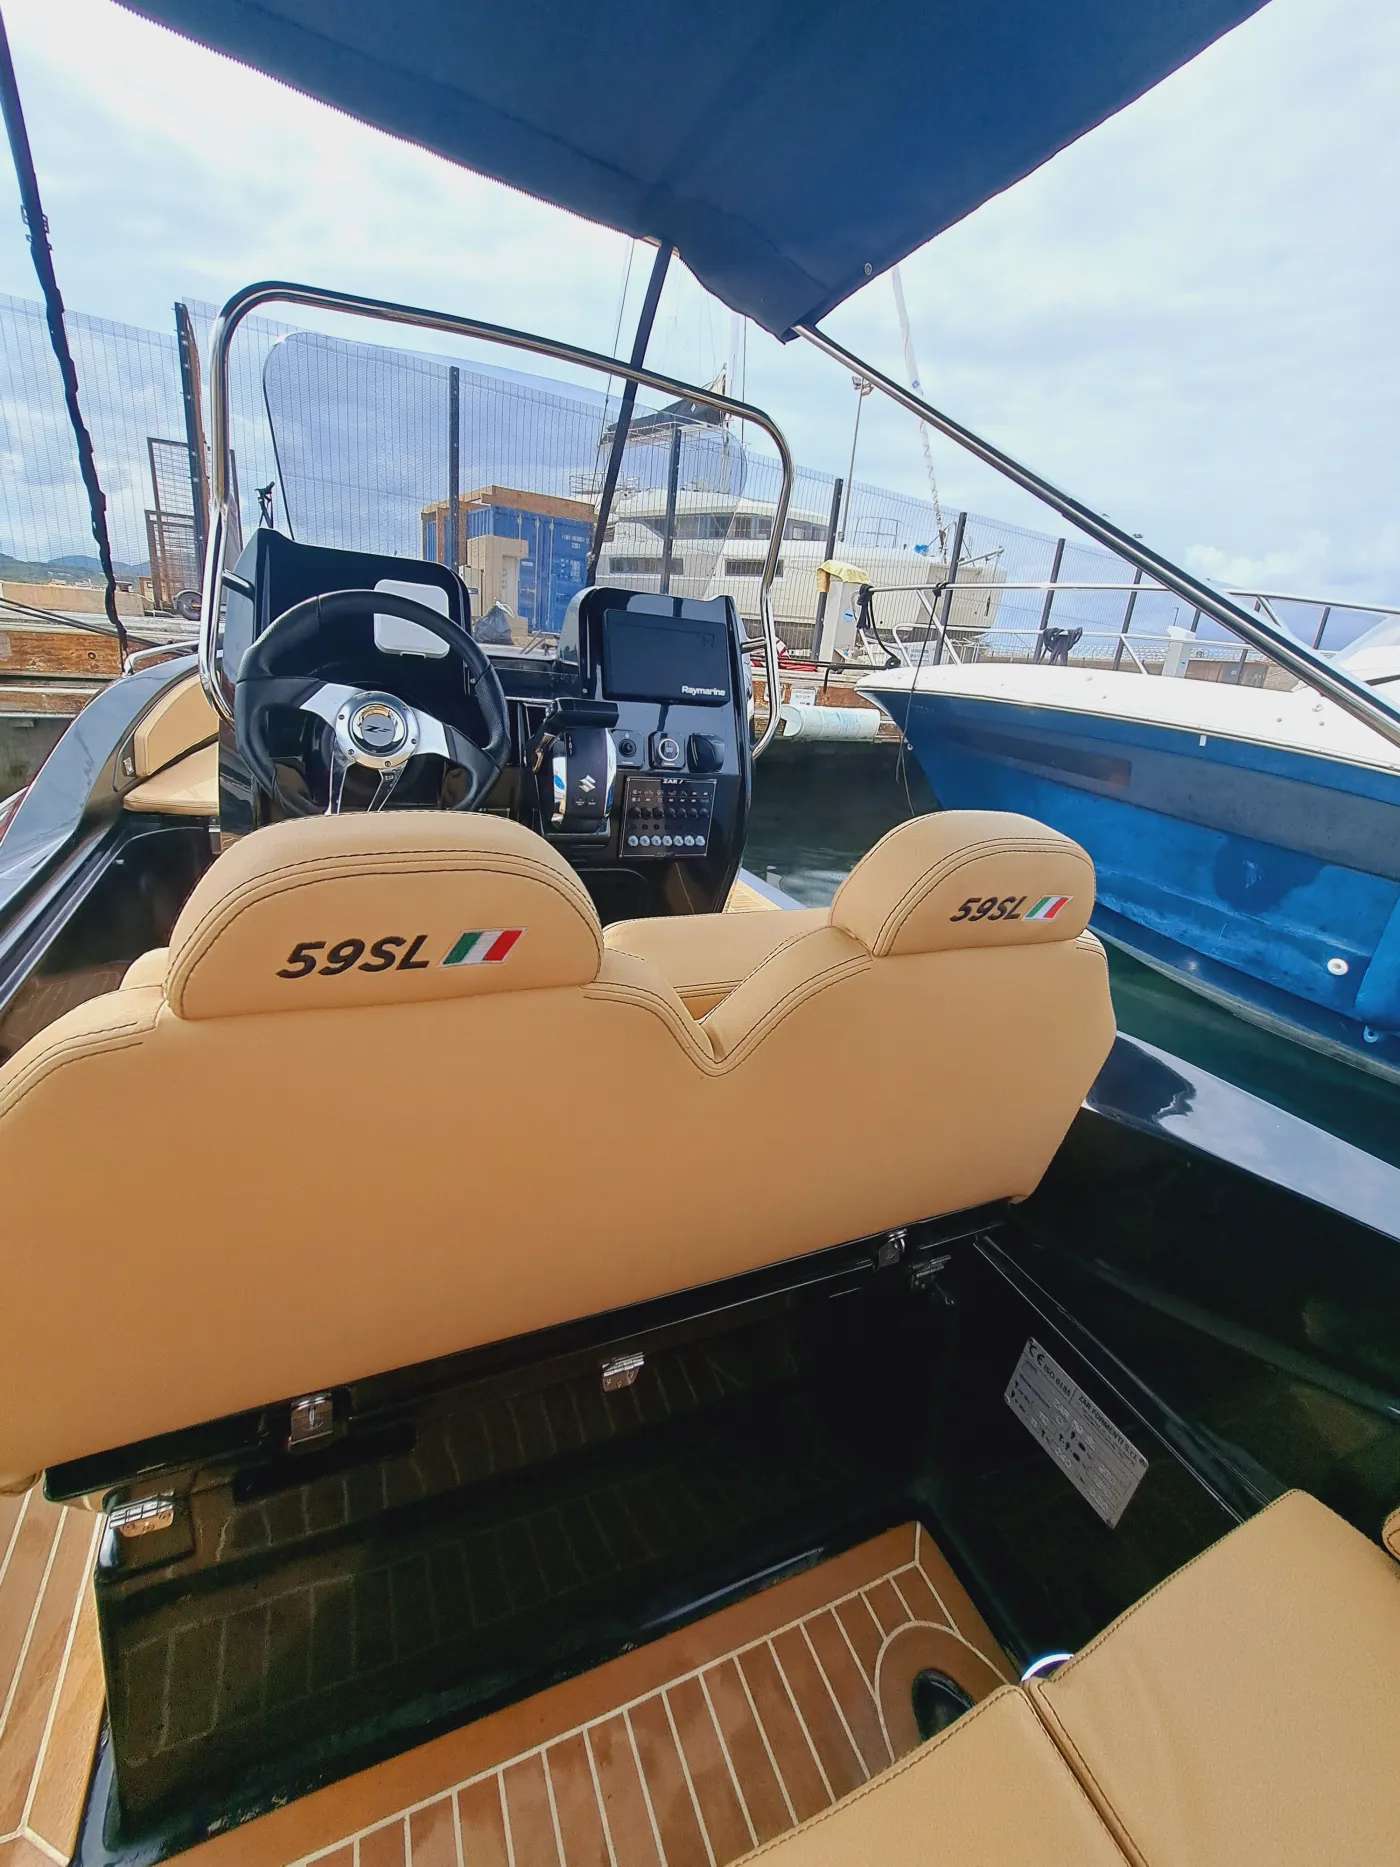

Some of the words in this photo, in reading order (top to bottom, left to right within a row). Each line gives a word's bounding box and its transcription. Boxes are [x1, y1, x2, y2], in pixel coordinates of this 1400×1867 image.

[681, 685, 726, 697] Raymarine
[949, 895, 1028, 922] 59SL
[274, 934, 430, 979] 59SL
[1042, 1363, 1055, 1380] ISO
[1078, 1394, 1091, 1410] ZAR
[1091, 1407, 1123, 1445] FORMENTI
